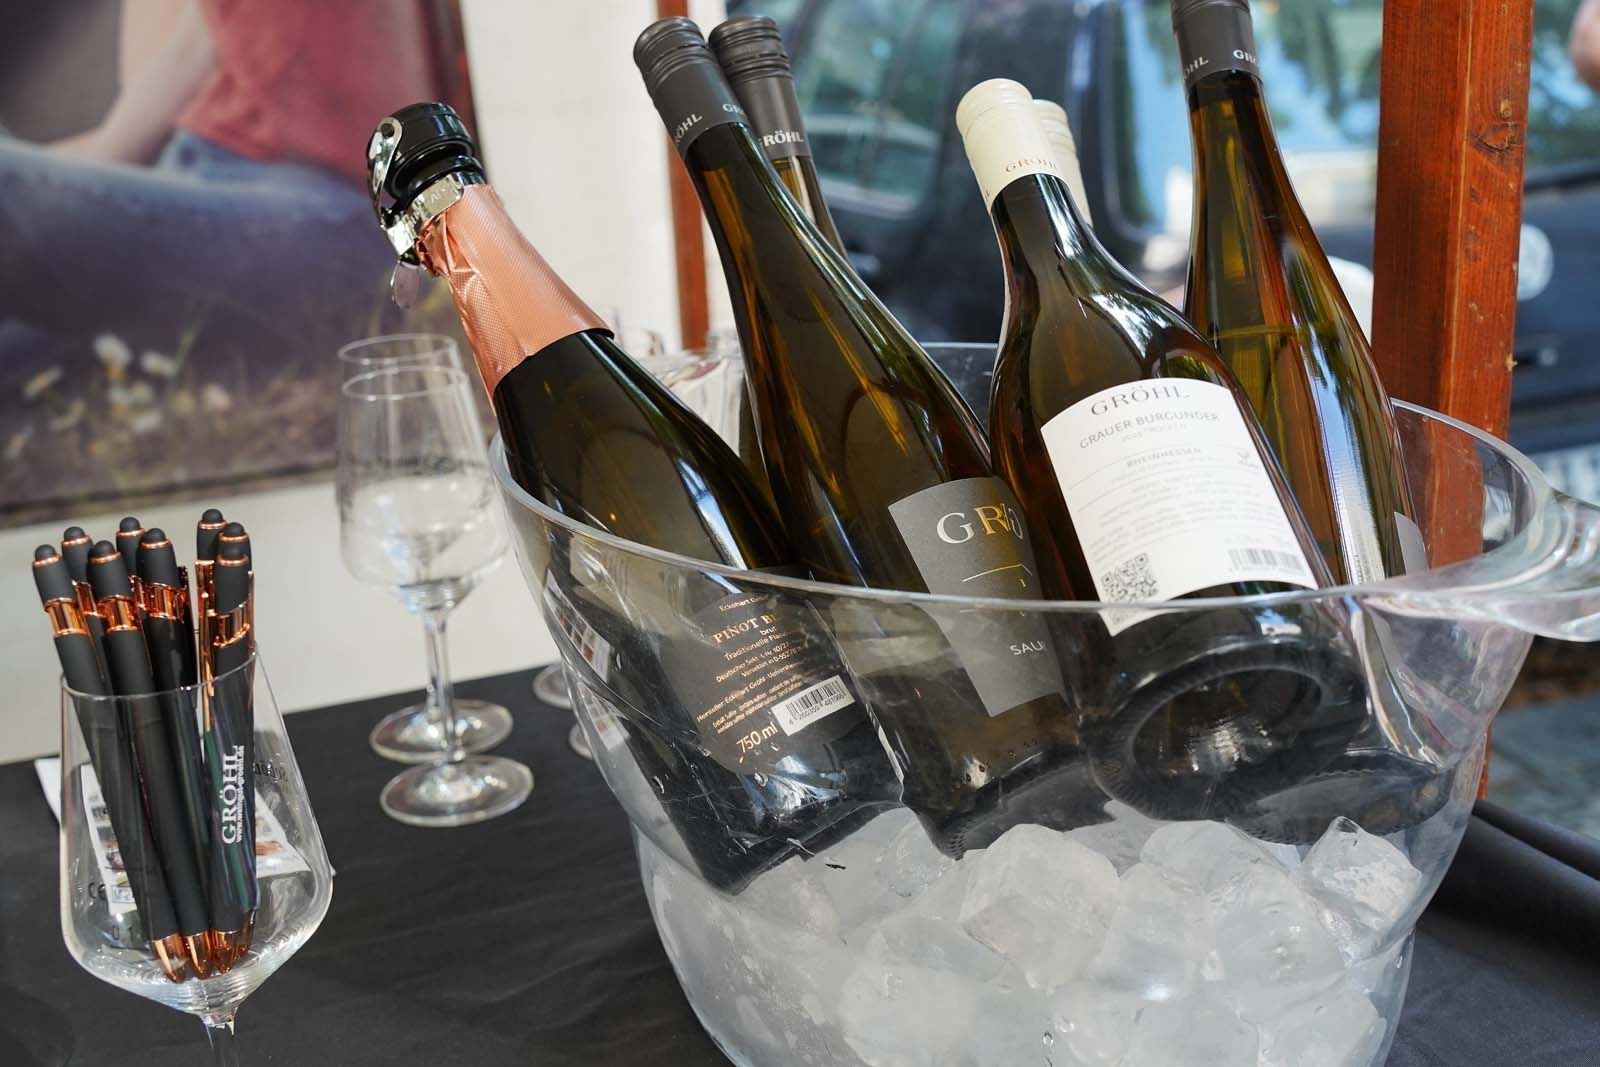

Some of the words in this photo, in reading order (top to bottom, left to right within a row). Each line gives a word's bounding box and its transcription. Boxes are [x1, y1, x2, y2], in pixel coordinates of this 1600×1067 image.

[758, 130, 804, 147] RÖHL
[1090, 384, 1191, 416] GRÖHL
[1078, 420, 1134, 450] GRAUER
[1135, 410, 1221, 427] BURGUNDER
[713, 617, 759, 644] PINOT
[760, 626, 777, 636] brut
[724, 638, 769, 662] Traditionelle
[736, 730, 762, 753] 750
[762, 721, 779, 740] ml
[219, 745, 239, 844] GRÖHL
